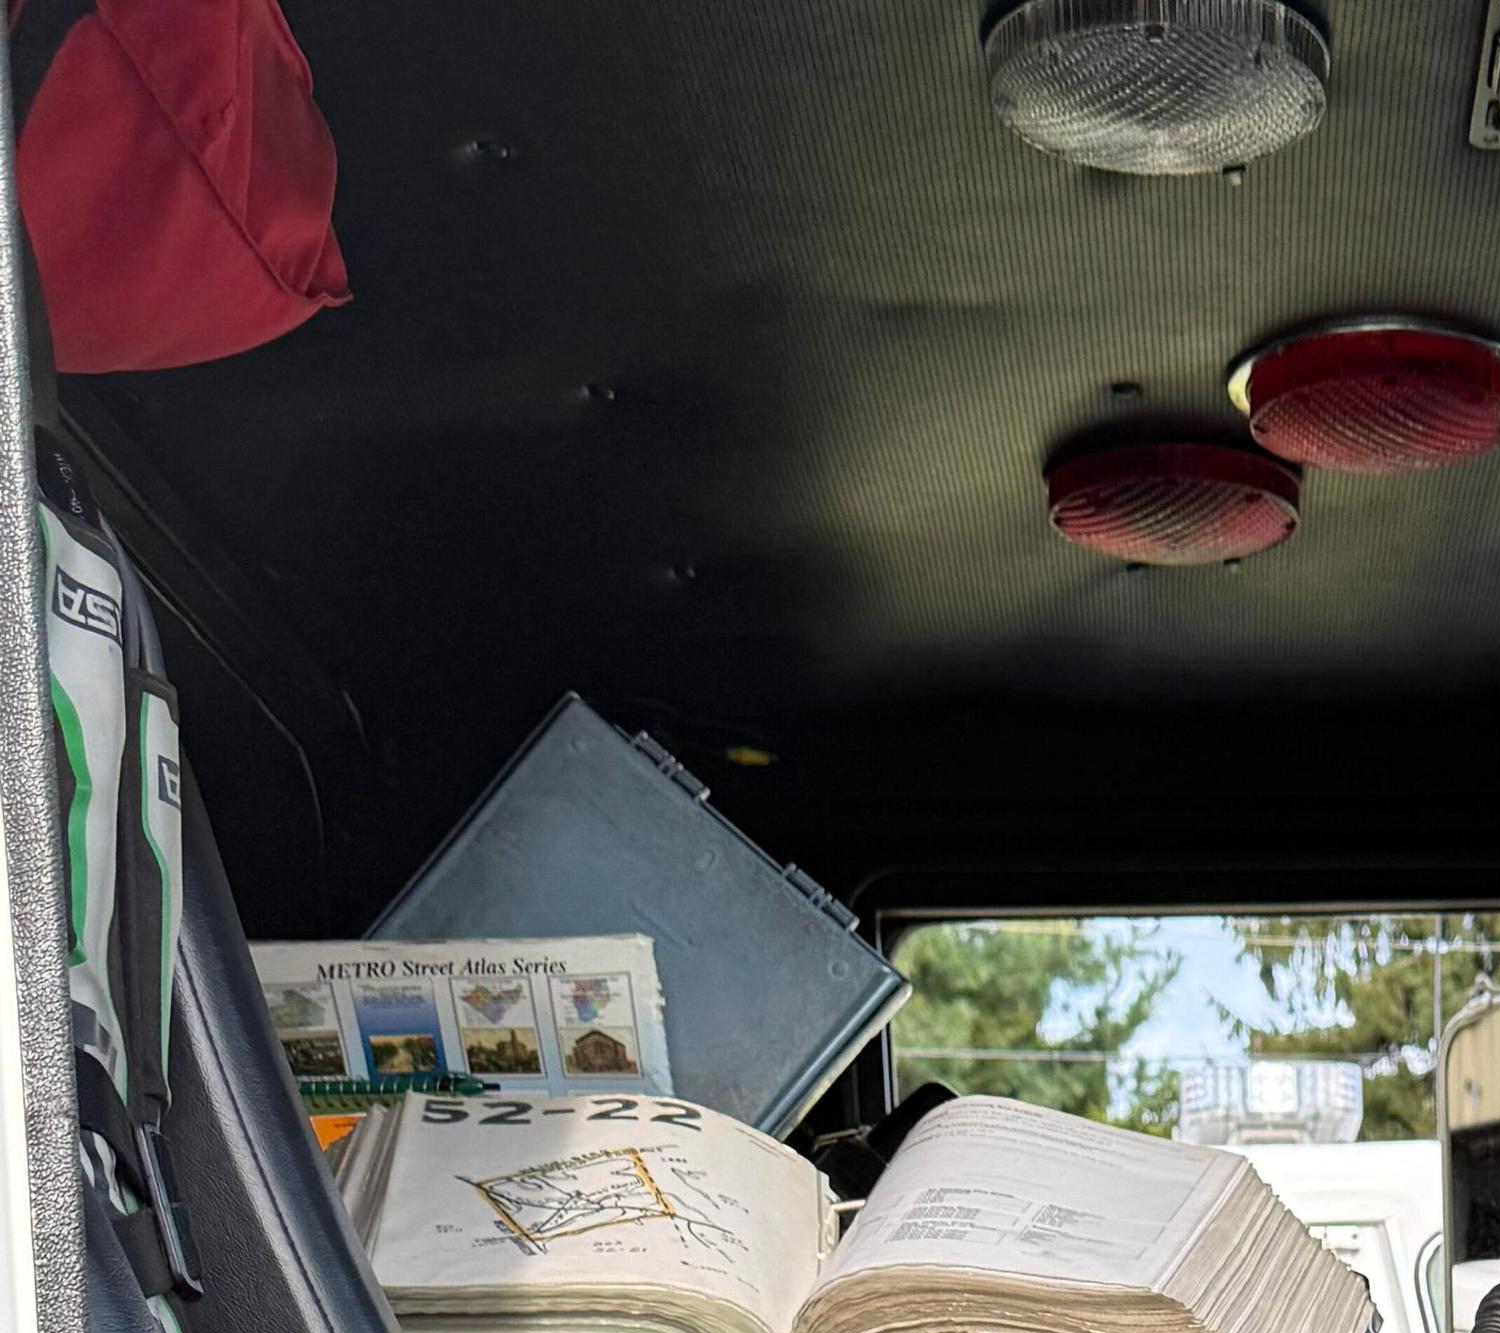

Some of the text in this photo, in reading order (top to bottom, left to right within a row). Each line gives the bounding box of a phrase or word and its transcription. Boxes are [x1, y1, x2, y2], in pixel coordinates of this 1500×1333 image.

[57, 573, 122, 645] SA
[317, 956, 567, 981] METRO Street Atlas Series
[421, 1100, 702, 1132] 52-22
